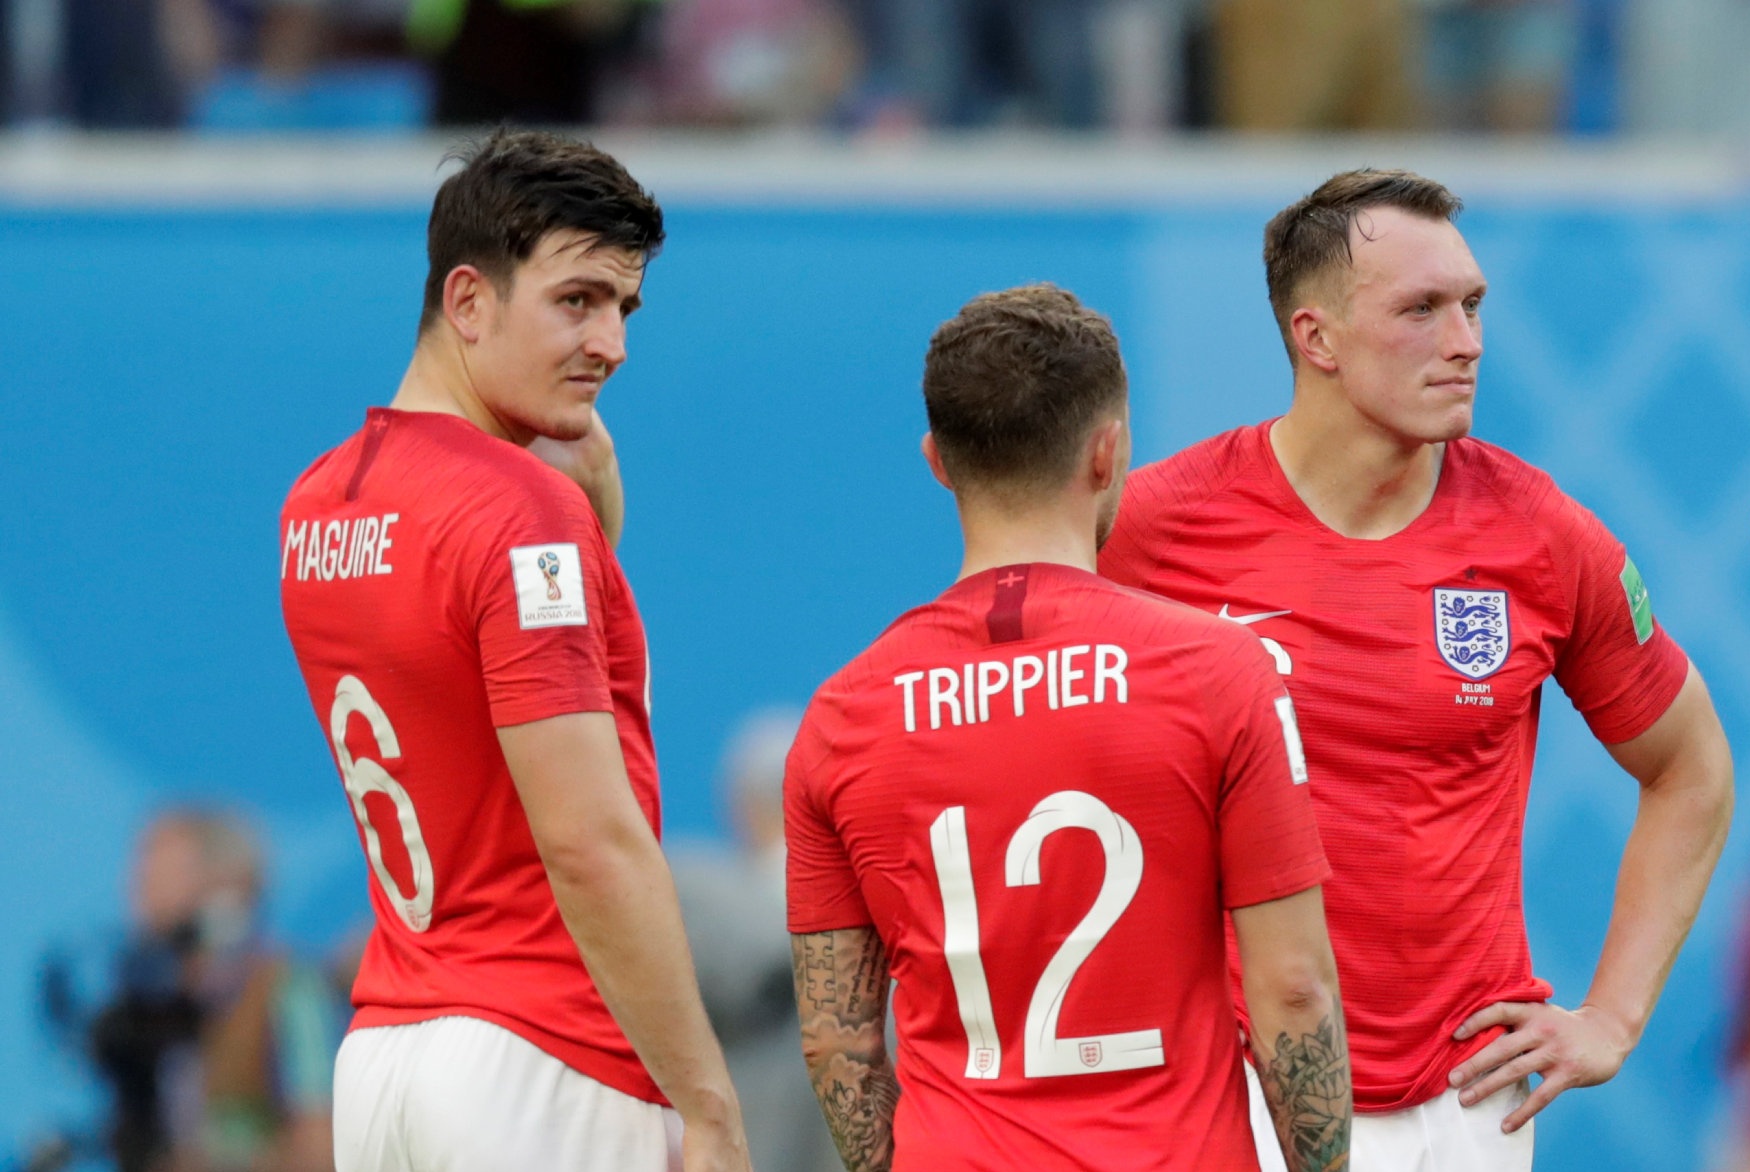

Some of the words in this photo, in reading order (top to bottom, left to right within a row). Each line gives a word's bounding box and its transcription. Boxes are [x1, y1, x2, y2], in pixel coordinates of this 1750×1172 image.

[281, 512, 400, 582] MAGUIRE
[893, 643, 1129, 733] TRIPPIER
[329, 674, 436, 934] 6
[928, 789, 1166, 1079] 12
